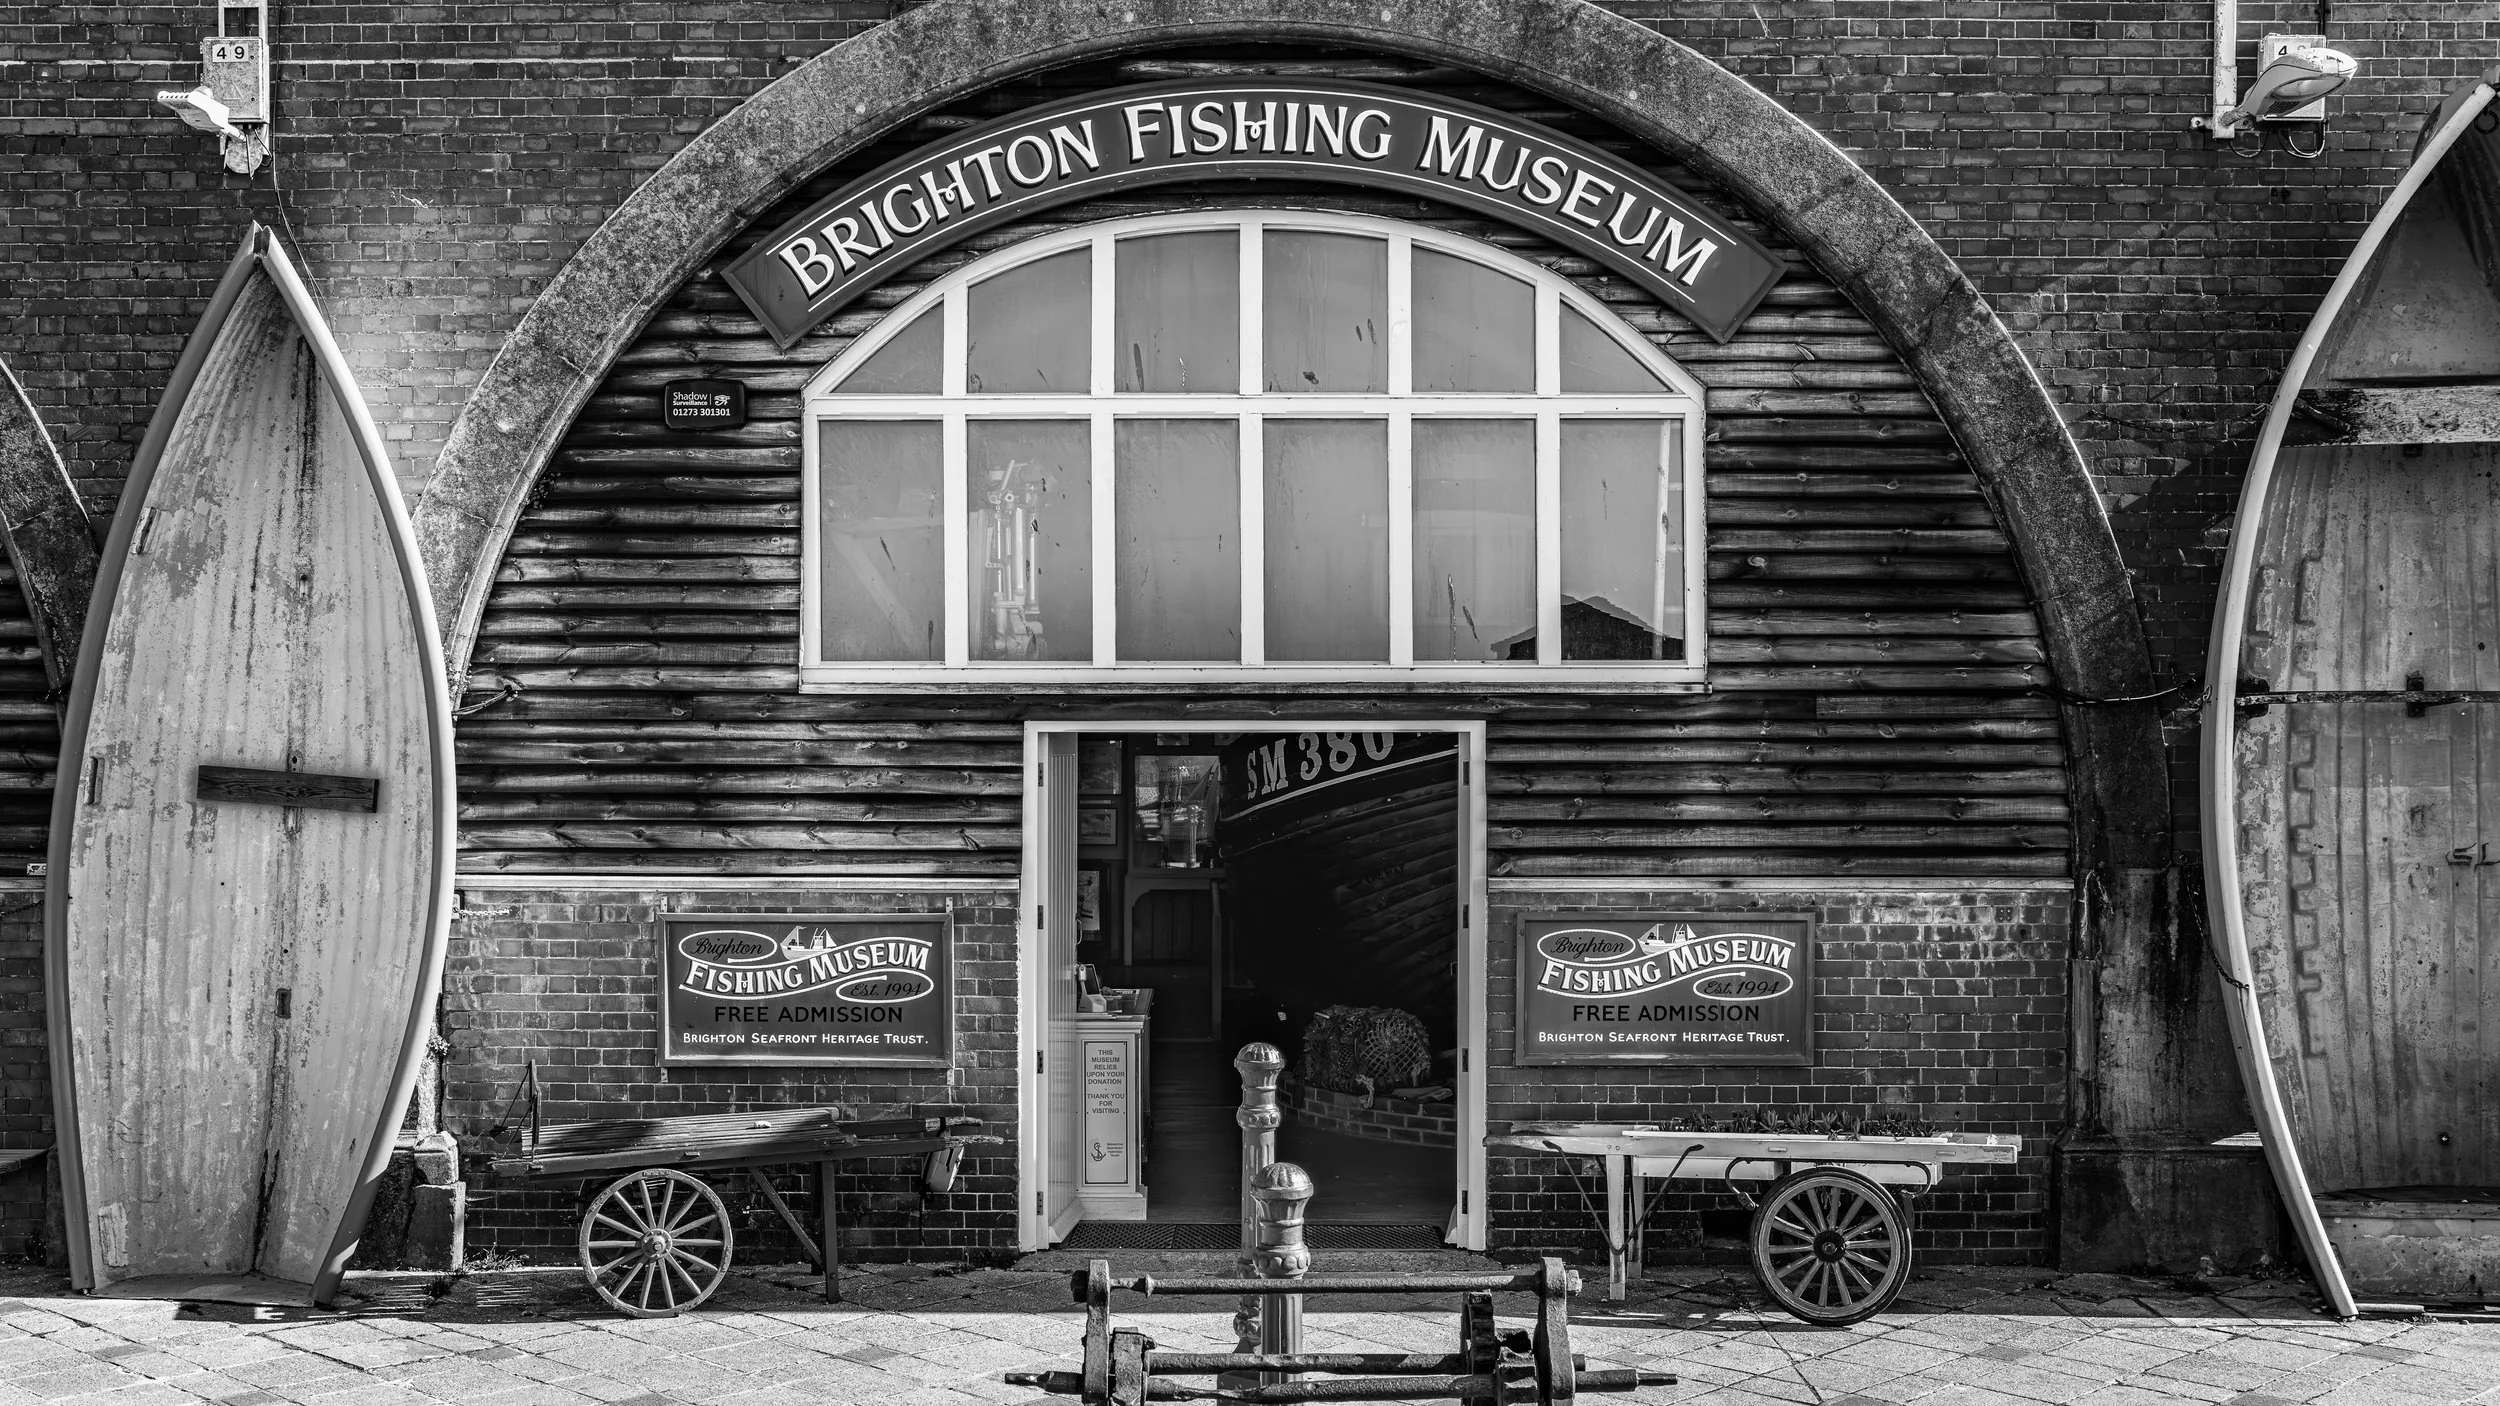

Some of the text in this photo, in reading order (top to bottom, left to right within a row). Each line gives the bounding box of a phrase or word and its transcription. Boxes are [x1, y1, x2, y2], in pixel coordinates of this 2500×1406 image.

[216, 46, 245, 60] 49
[778, 101, 1719, 297] BRIGHTON FISHING MUSEUM
[672, 391, 708, 401] Shadow
[672, 408, 731, 417] 01273 301301
[1247, 738, 1289, 800] SM
[690, 937, 763, 962] Brighton
[1550, 936, 1625, 960] Brighton
[683, 943, 930, 995] FISHING MUSEUM
[1540, 939, 1793, 993] FISHING MUSEUM
[850, 981, 922, 997] Est. 1994
[1704, 980, 1780, 995] Est. 1994
[714, 1006, 903, 1023] FREE ADMISSION
[1573, 1005, 1759, 1021] FREE ADMISSION
[683, 1032, 929, 1044] BRIGHTON SEAFRONT HERITAGE TRUST.
[1538, 1031, 1790, 1043] BRIGHTON SEAFRONT HERITAGE TRUST.
